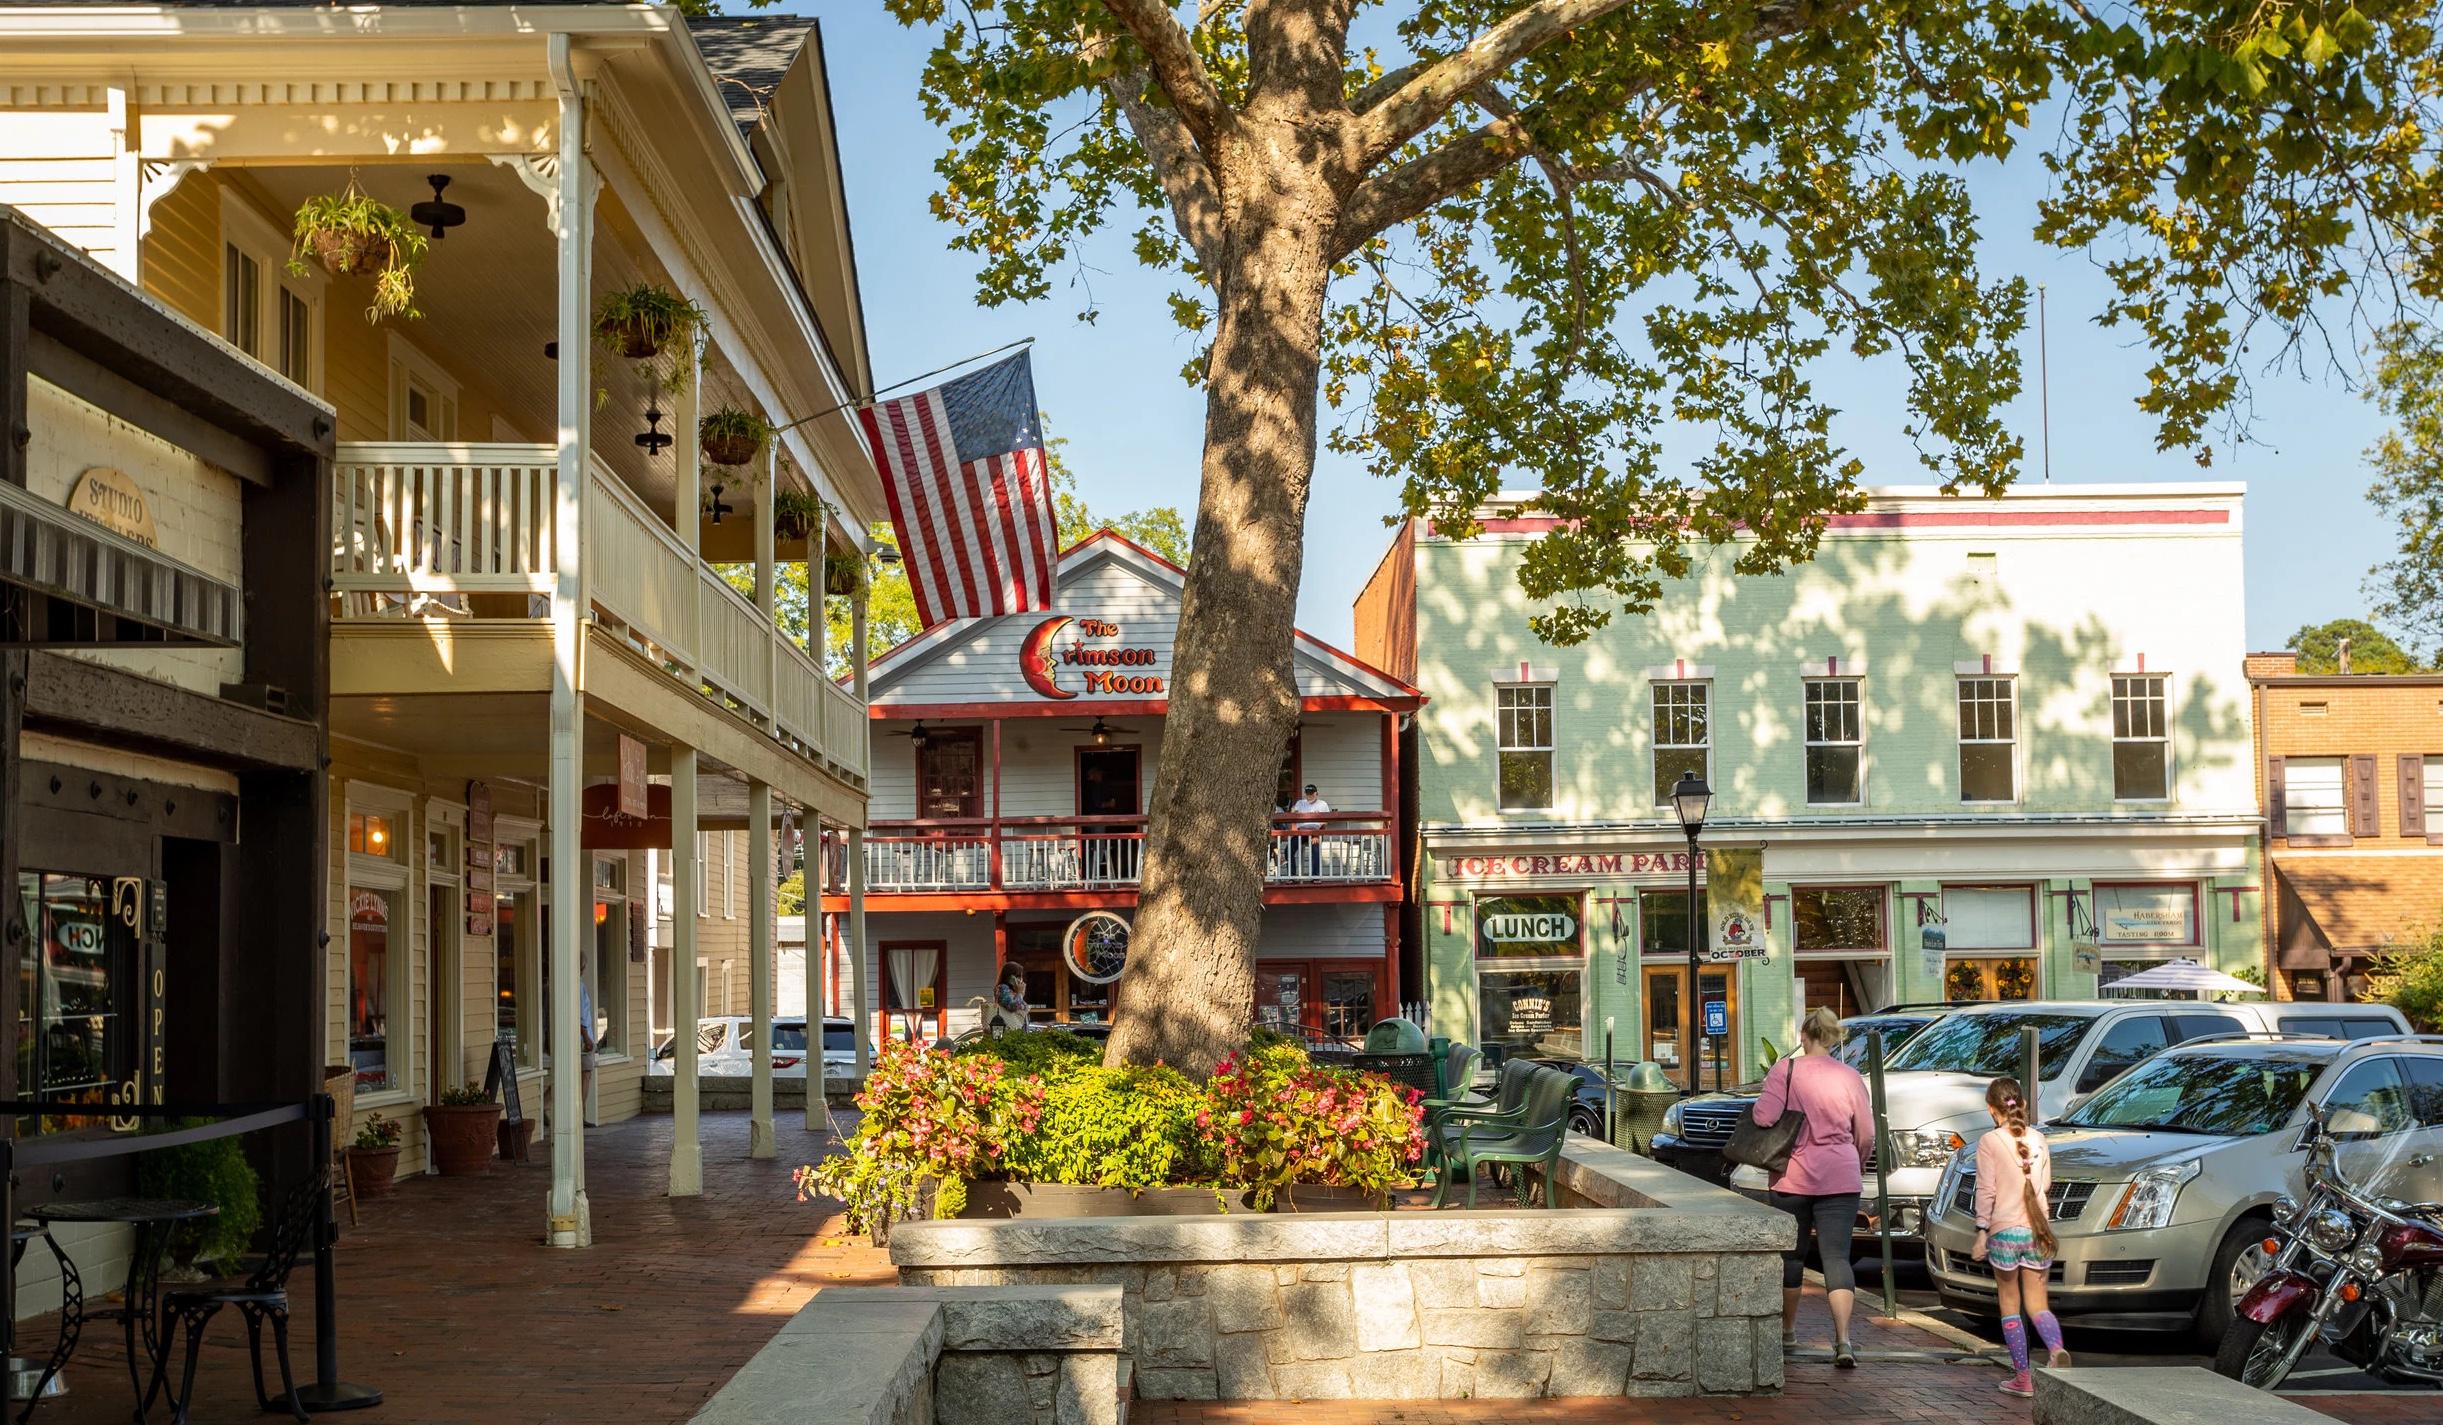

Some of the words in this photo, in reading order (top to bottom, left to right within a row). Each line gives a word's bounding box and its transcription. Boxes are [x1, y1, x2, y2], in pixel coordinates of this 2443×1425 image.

[90, 478, 142, 524] STUDIO
[1079, 619, 1119, 637] The
[1083, 671, 1164, 694] Moon
[1454, 855, 1506, 875] ICE
[1512, 853, 1622, 875] CREAM
[2134, 911, 2182, 920] HABERSHAM
[1492, 917, 1565, 938] LUNCH
[1512, 998, 1551, 1011] CONNIE'S
[153, 969, 163, 1105] OPEN
